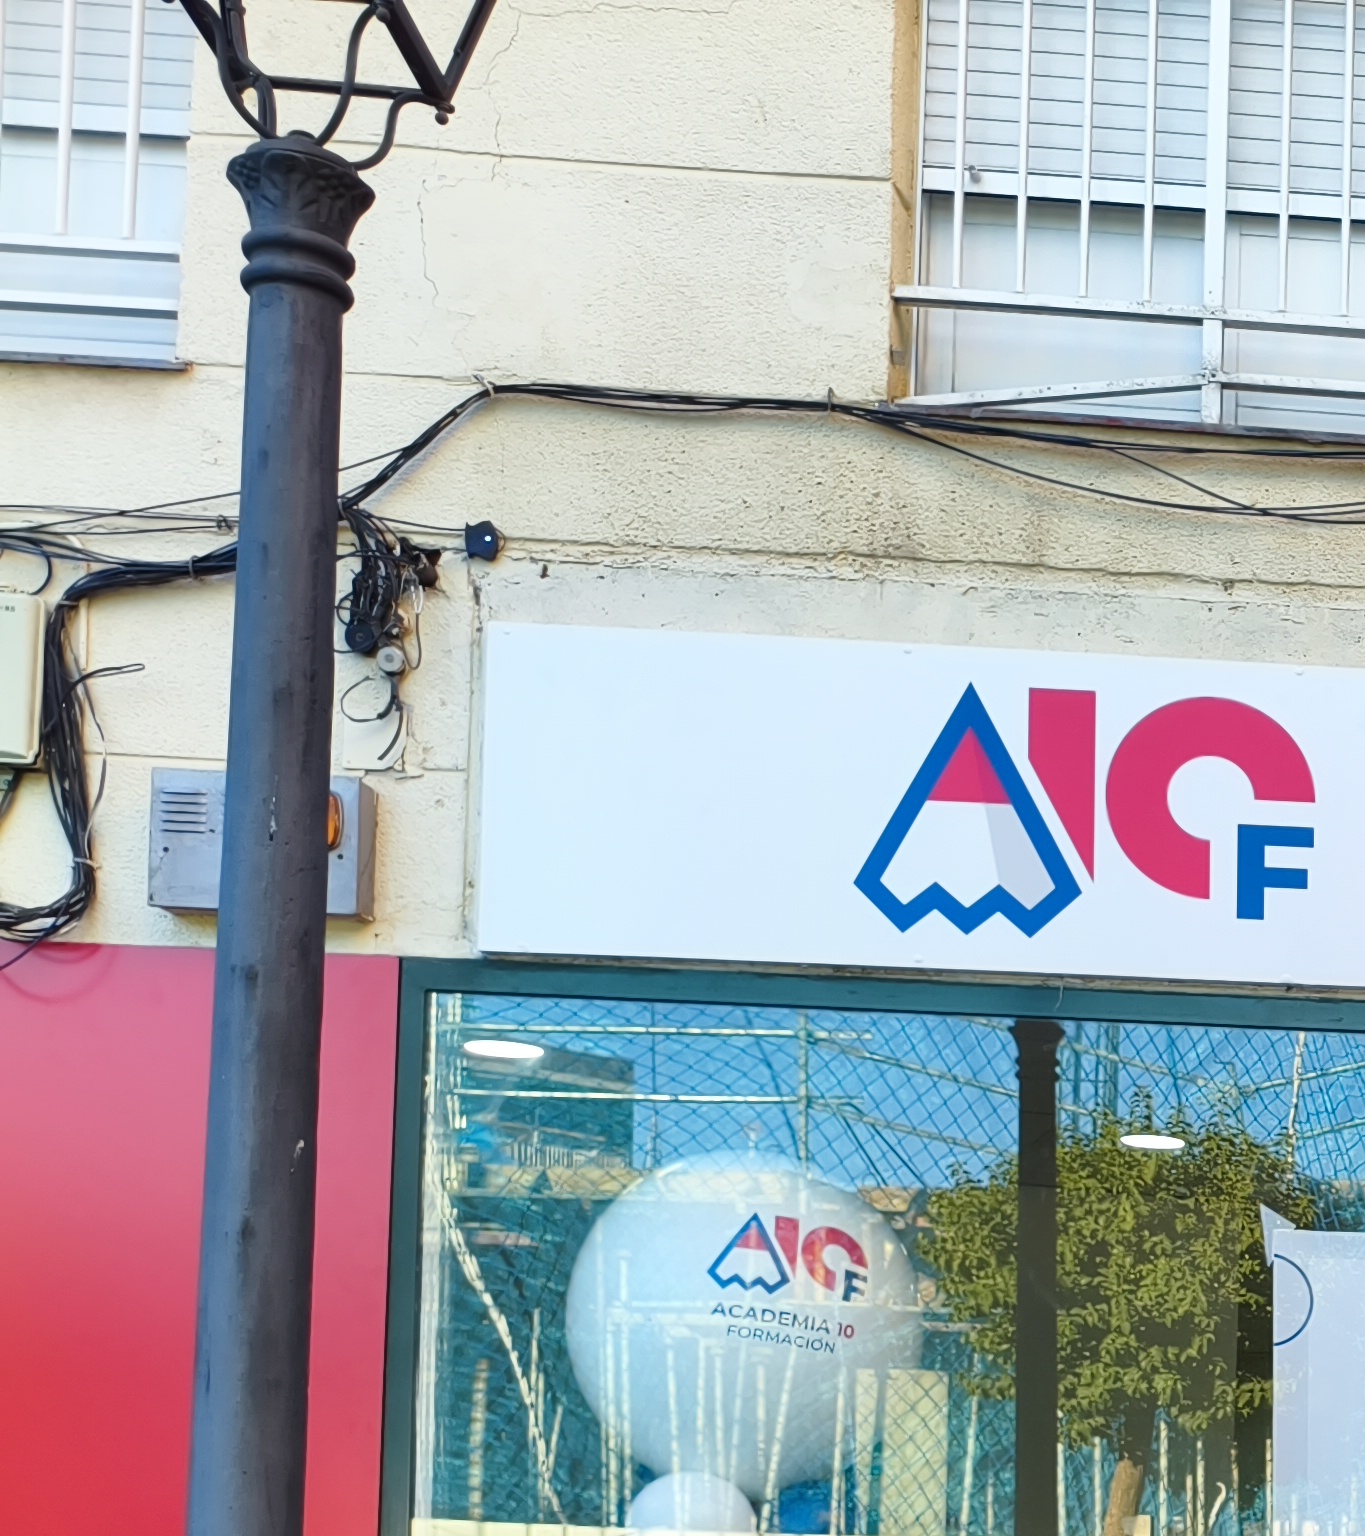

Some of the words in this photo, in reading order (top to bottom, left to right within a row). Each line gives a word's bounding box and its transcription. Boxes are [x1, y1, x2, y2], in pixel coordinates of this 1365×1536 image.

[711, 1302, 830, 1335] ACADEMIA
[837, 1322, 855, 1339] 10
[727, 1325, 835, 1354] FORMACIÓN
